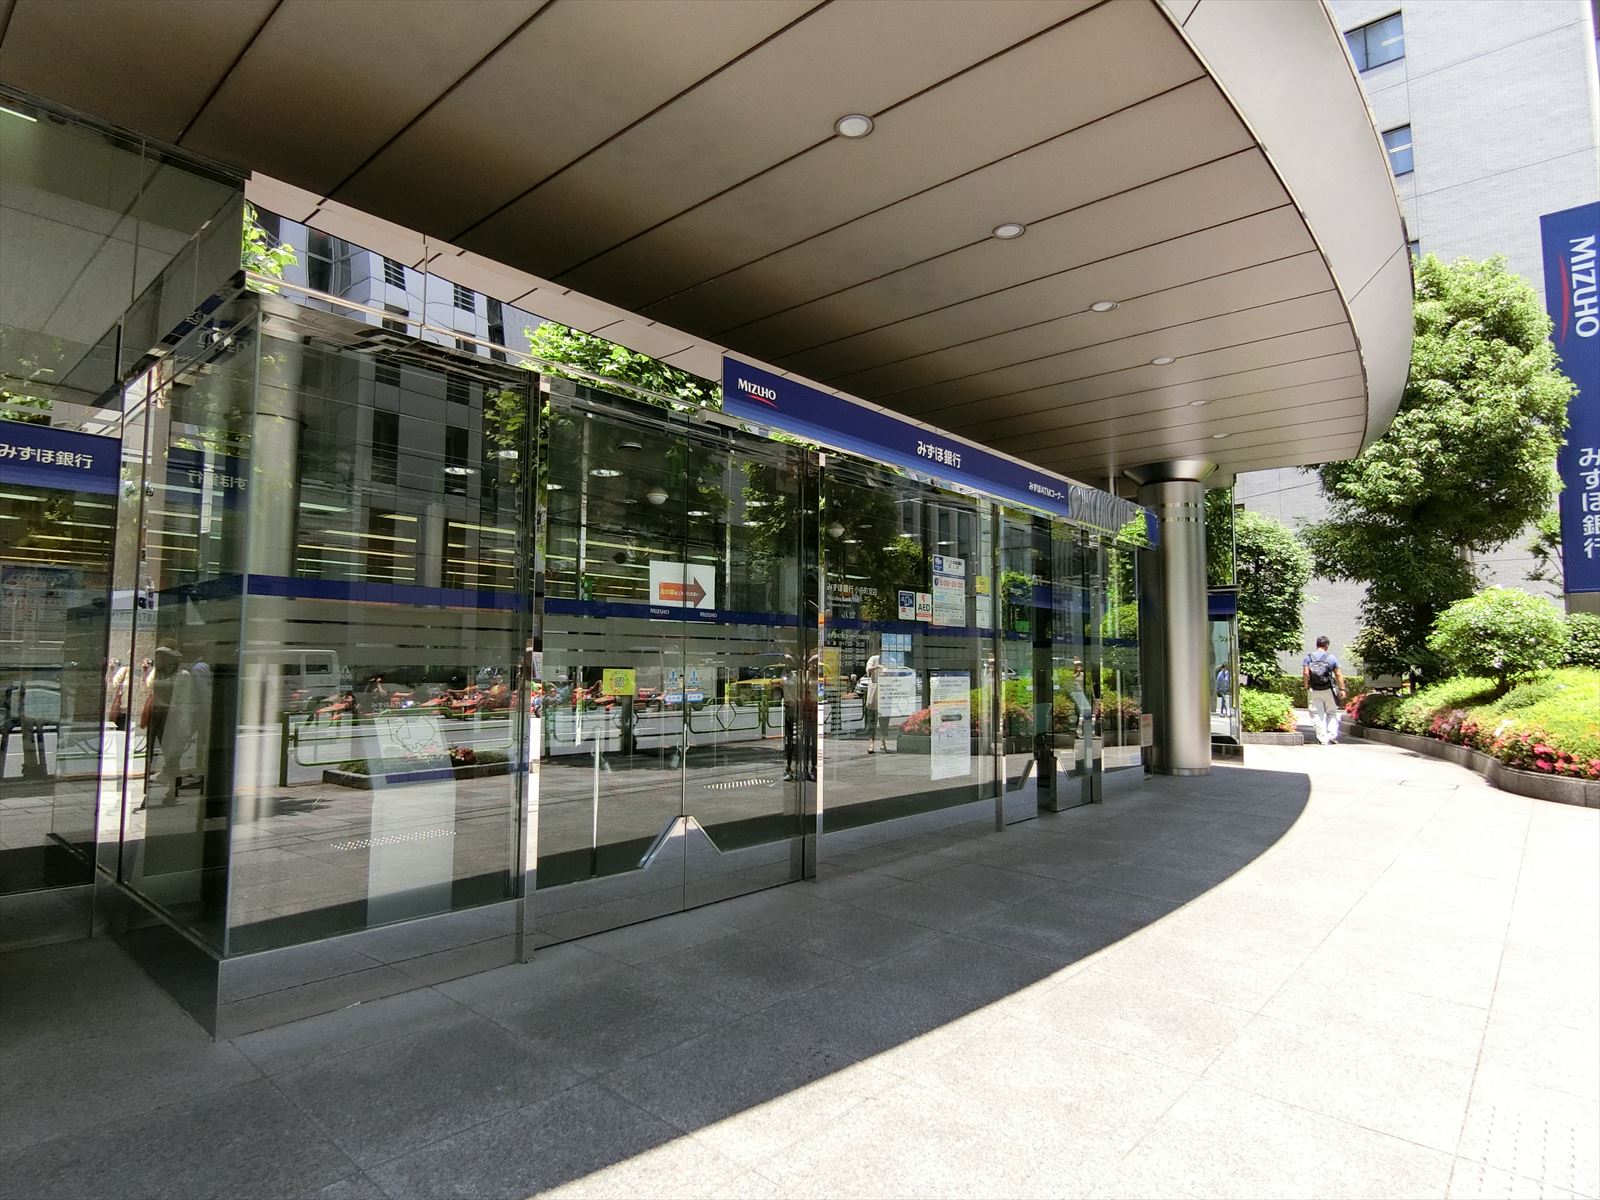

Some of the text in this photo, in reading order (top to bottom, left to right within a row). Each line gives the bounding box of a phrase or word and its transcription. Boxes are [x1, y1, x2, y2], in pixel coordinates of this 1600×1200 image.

[1568, 234, 1600, 338] MIZUHO
[737, 378, 777, 401] MIZUHO
[0, 443, 94, 469] みずほ銀行
[916, 440, 961, 469] みずほ銀行
[1028, 481, 1065, 500] みずほATMコーナー
[650, 607, 670, 615] MIZUHO
[917, 603, 931, 612] AED
